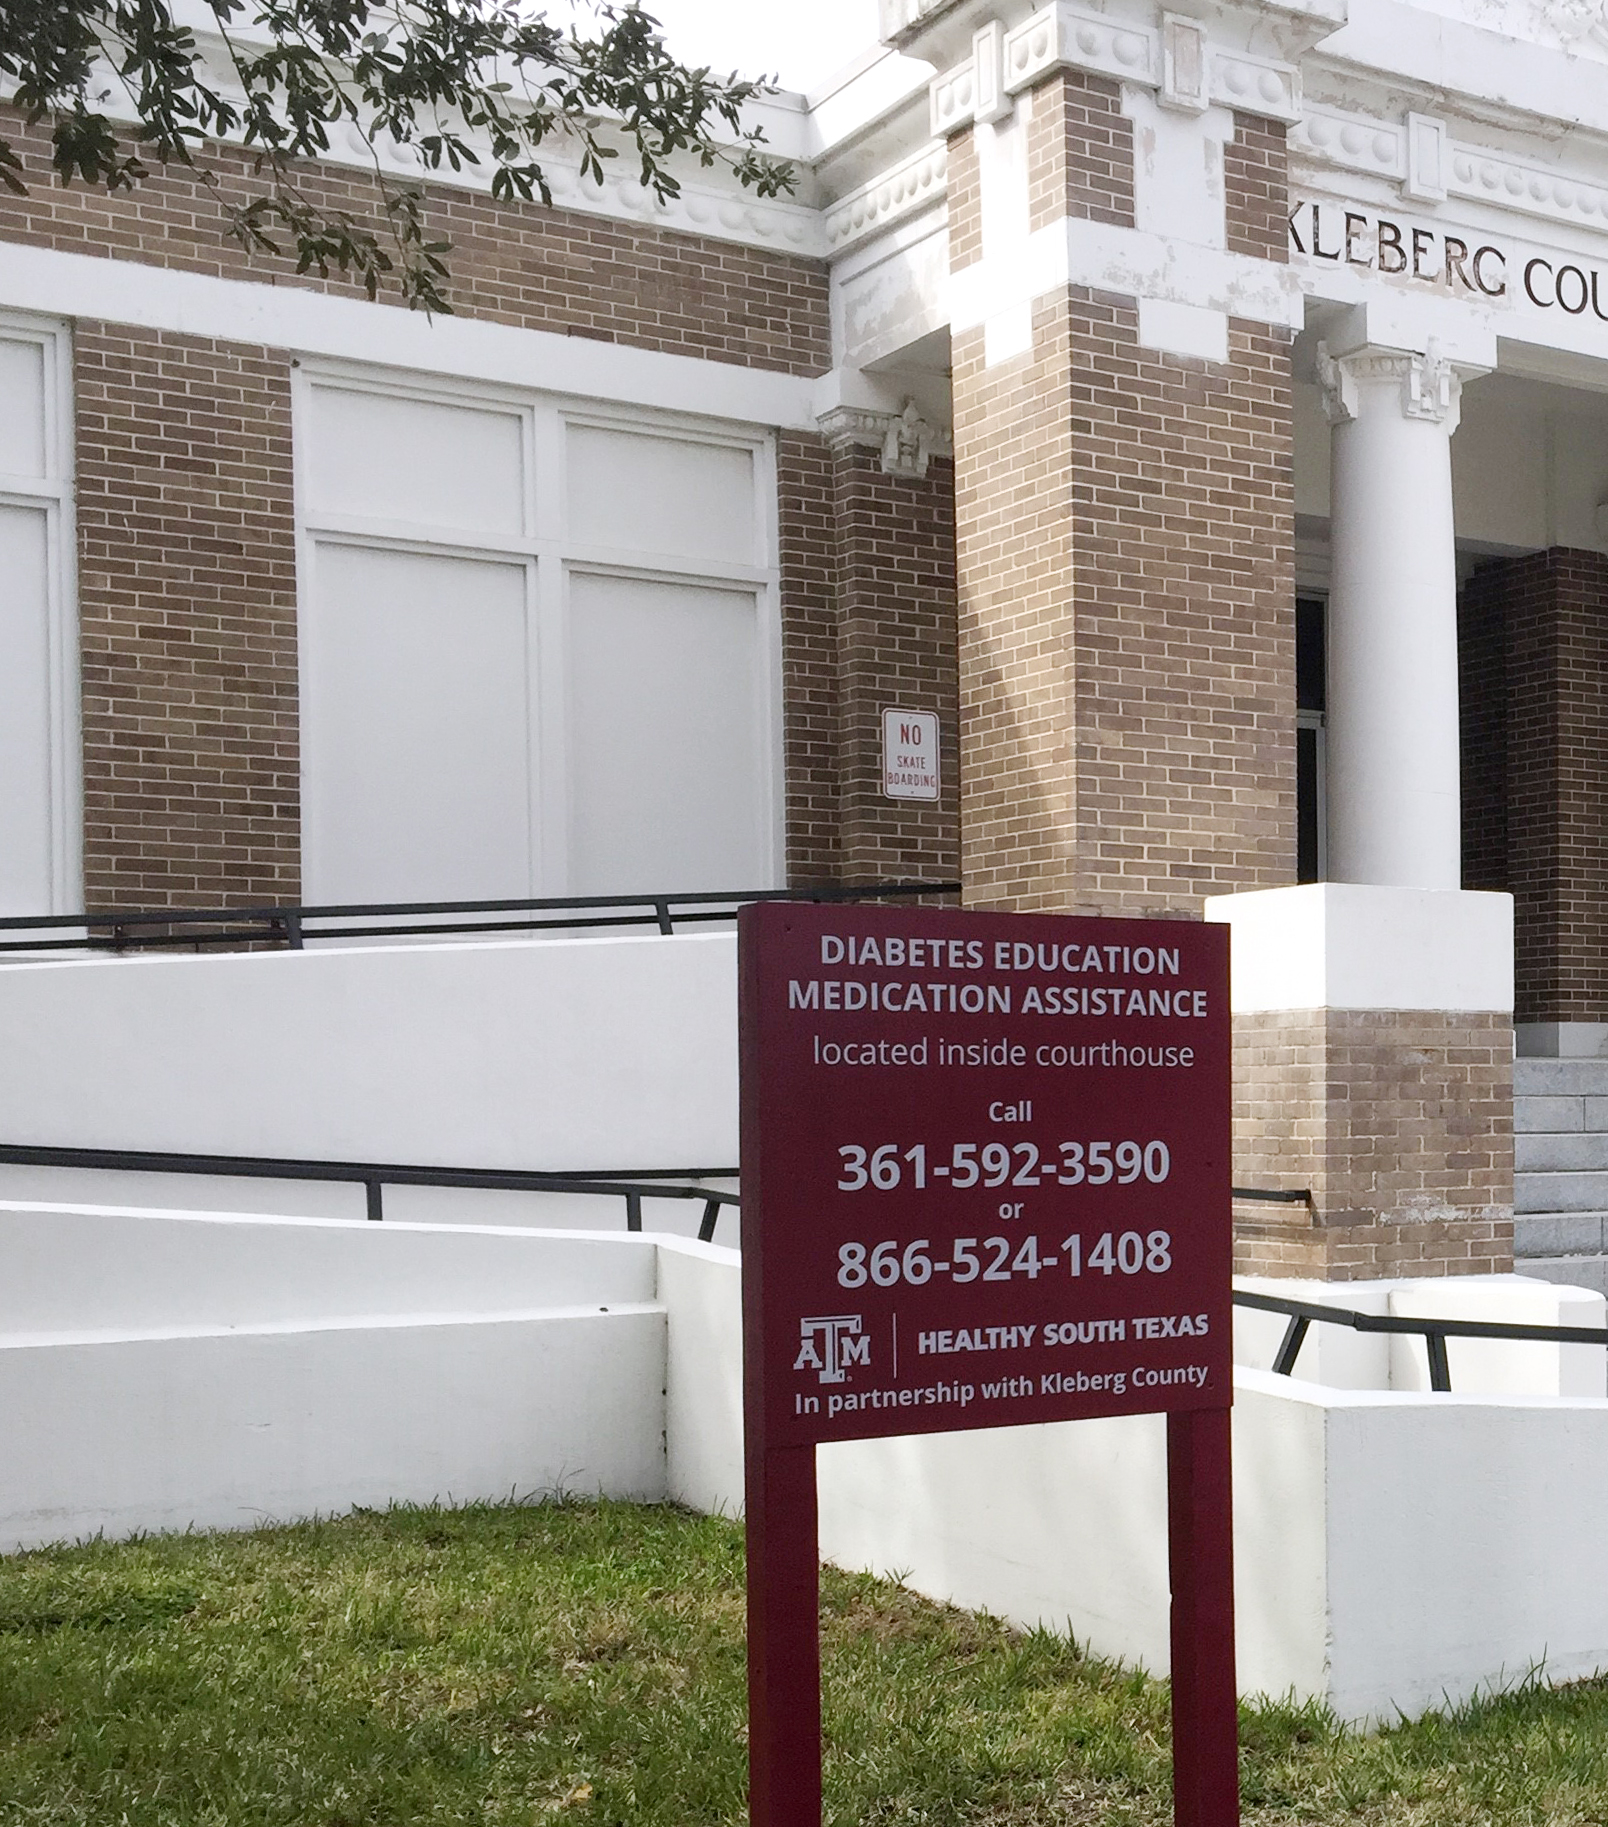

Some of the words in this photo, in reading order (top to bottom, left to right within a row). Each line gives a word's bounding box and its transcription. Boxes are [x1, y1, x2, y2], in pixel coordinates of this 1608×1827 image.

[900, 723, 922, 746] NO
[897, 755, 926, 770] SKATE
[887, 772, 936, 788] BOARDING
[821, 935, 984, 969] DIABETES
[994, 942, 1180, 976] EDUCATION
[788, 980, 1011, 1014] MEDICATION
[1021, 987, 1208, 1017] ASSISTANCE
[814, 1035, 928, 1066] located
[939, 1037, 1026, 1066] inside
[1035, 1039, 1194, 1067] courthouse
[989, 1100, 1032, 1122] Call
[837, 1140, 1170, 1191] 361-592-3590
[998, 1202, 1025, 1220] or
[837, 1230, 1172, 1289] 866-524-1408
[918, 1324, 1036, 1355] HEALTHY
[1043, 1319, 1126, 1346] SOUTH
[1131, 1313, 1209, 1340] TEXAS
[795, 1393, 819, 1415] In
[828, 1379, 975, 1419] partnership
[981, 1375, 1033, 1399] with
[1041, 1370, 1127, 1395] Kleberg
[1132, 1364, 1209, 1388] County
